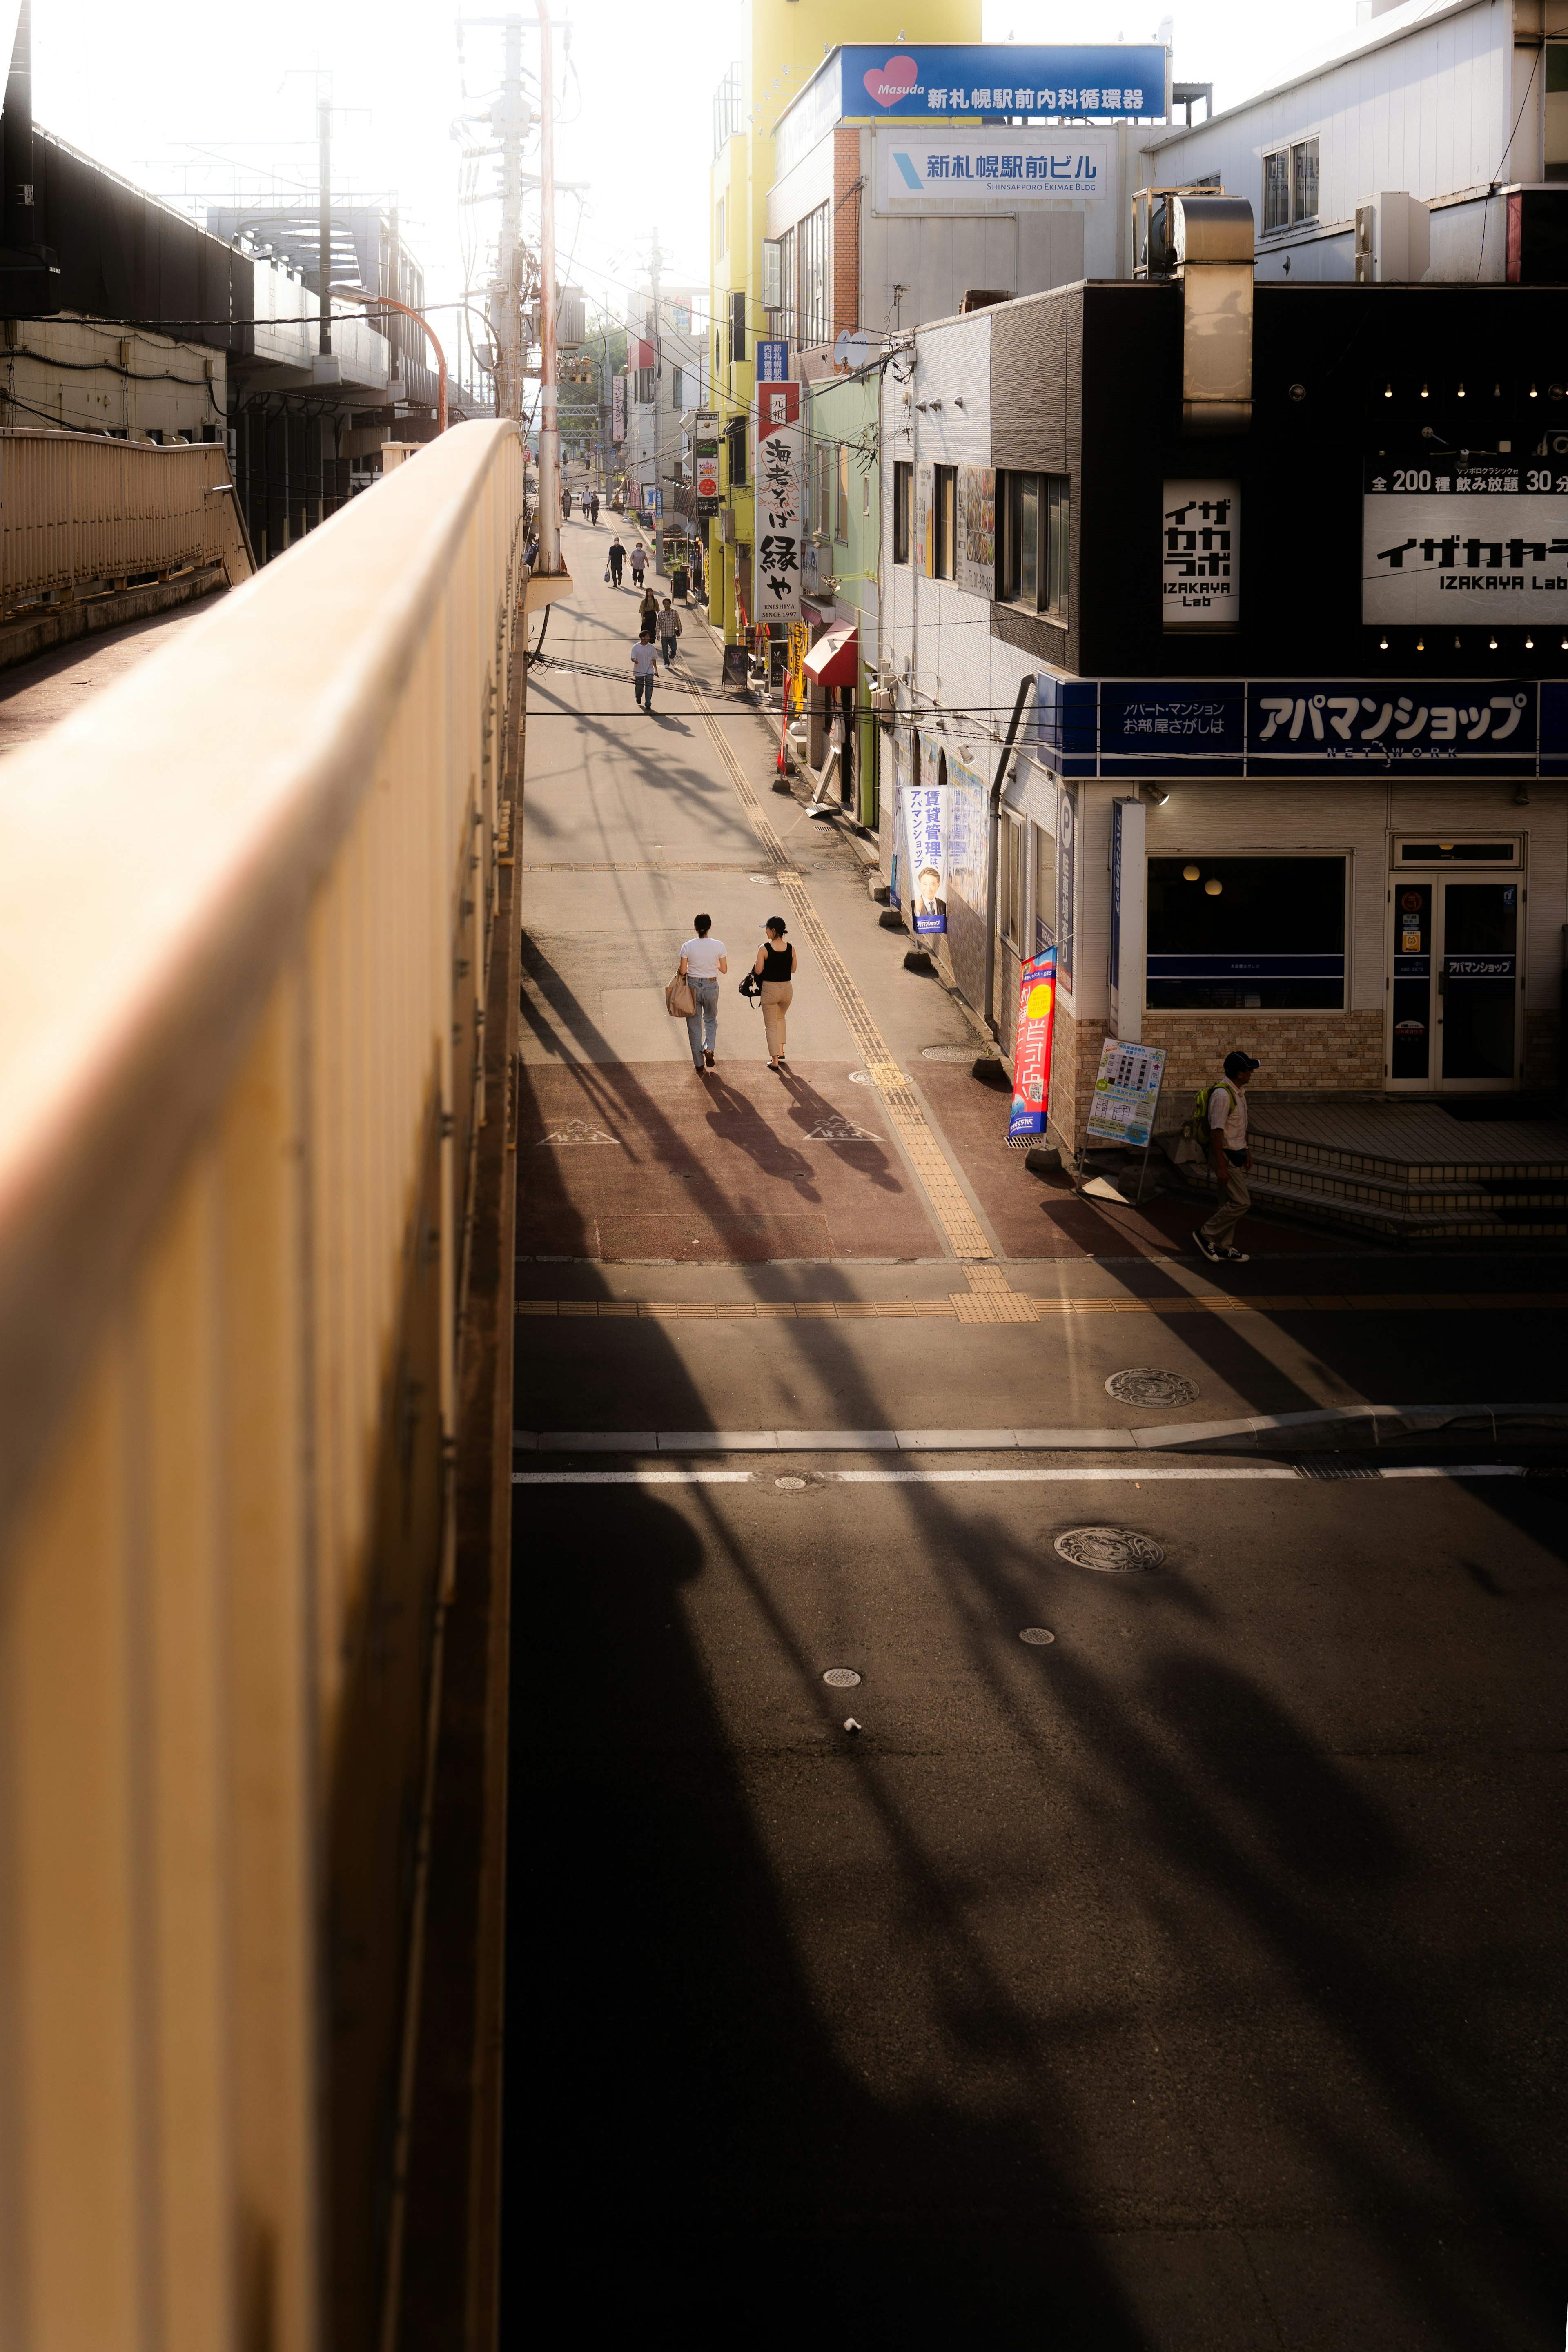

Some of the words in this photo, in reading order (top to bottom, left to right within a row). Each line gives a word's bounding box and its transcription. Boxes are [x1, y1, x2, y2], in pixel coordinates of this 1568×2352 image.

[878, 84, 925, 95] Masuda
[927, 88, 1144, 109] 新札幌駅前内科循環器
[927, 155, 1097, 178] 新札幌駅前ビル
[986, 183, 1042, 192] SHINSAPPORO
[1044, 183, 1074, 192] EKIMAE
[766, 439, 791, 528] 海老そば
[1165, 499, 1231, 525] イザ
[760, 535, 800, 600] 縁や
[1164, 552, 1231, 576] ラボ
[1163, 583, 1231, 594] IZAKAYA
[1440, 576, 1524, 590] IZAKAYA
[1532, 576, 1567, 590] Lab
[1183, 596, 1211, 607] Lab
[1123, 703, 1225, 716] アパート・マンション
[1259, 693, 1528, 742] アパマンショップ
[1123, 718, 1225, 734] お部屋さがしは
[911, 791, 924, 869] アパマンショップ
[1063, 805, 1070, 840] P
[1449, 961, 1511, 973] アパマンショップ
